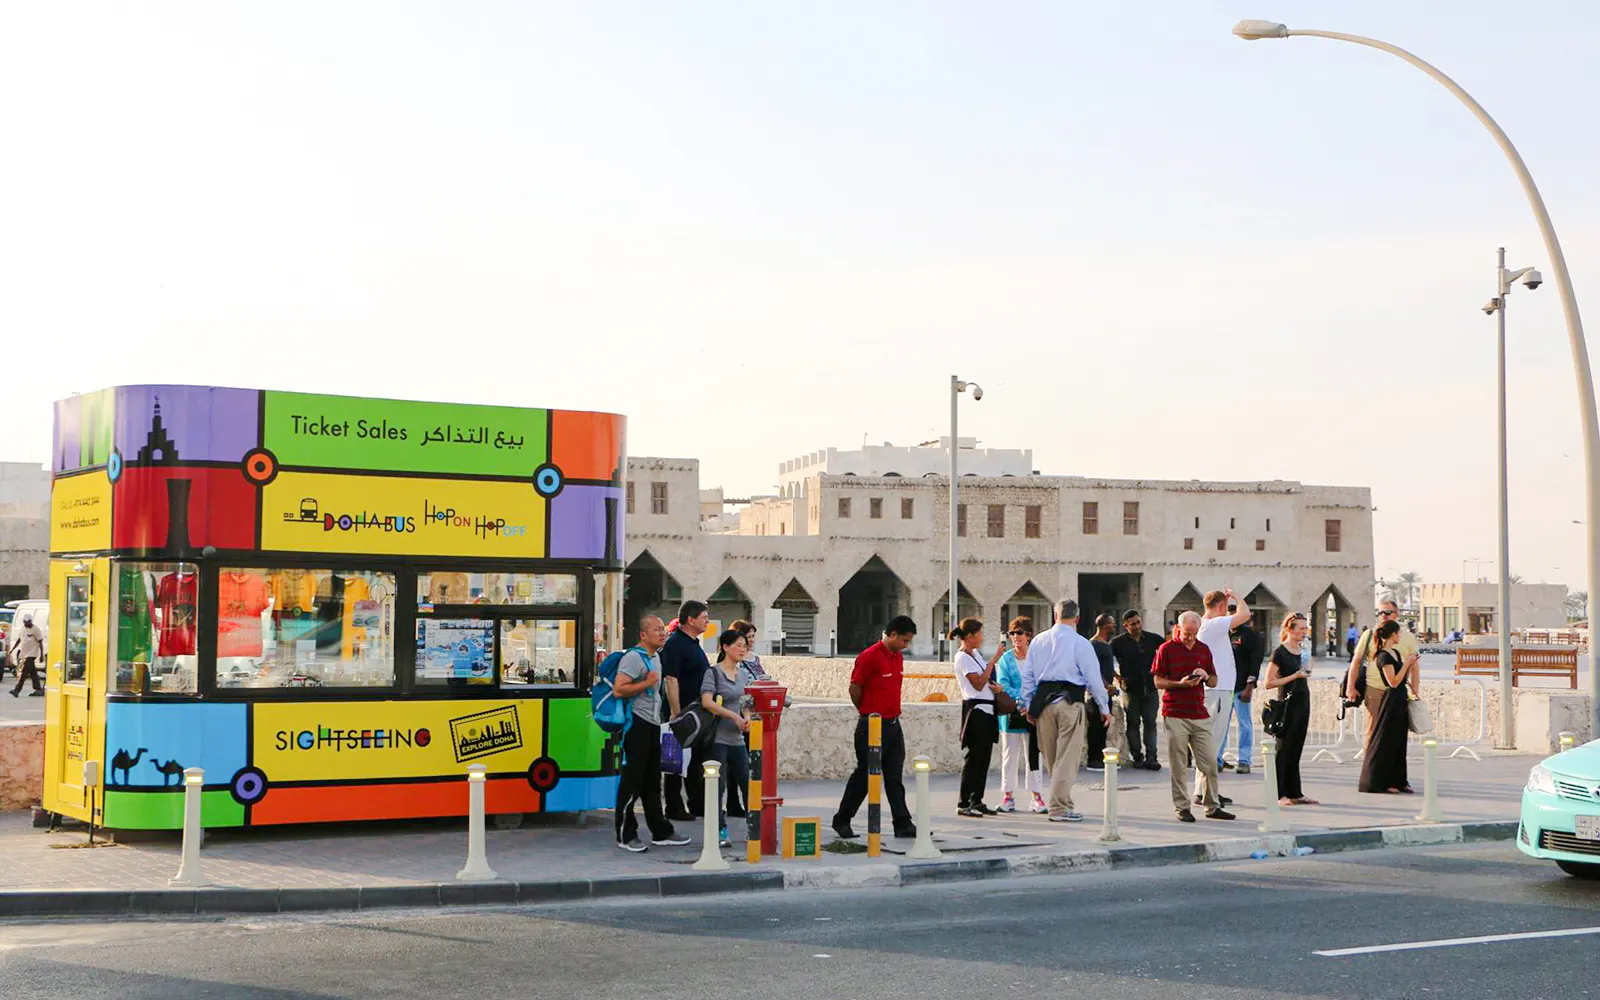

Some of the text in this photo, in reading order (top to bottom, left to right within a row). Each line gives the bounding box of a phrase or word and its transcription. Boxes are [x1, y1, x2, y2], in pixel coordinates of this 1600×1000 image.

[291, 415, 408, 441] Ticket Sales
[420, 424, 524, 450] بيع التذاكر
[453, 516, 471, 527] ON
[503, 525, 527, 537] OFF
[461, 734, 515, 754] EXPLORE DOHA
